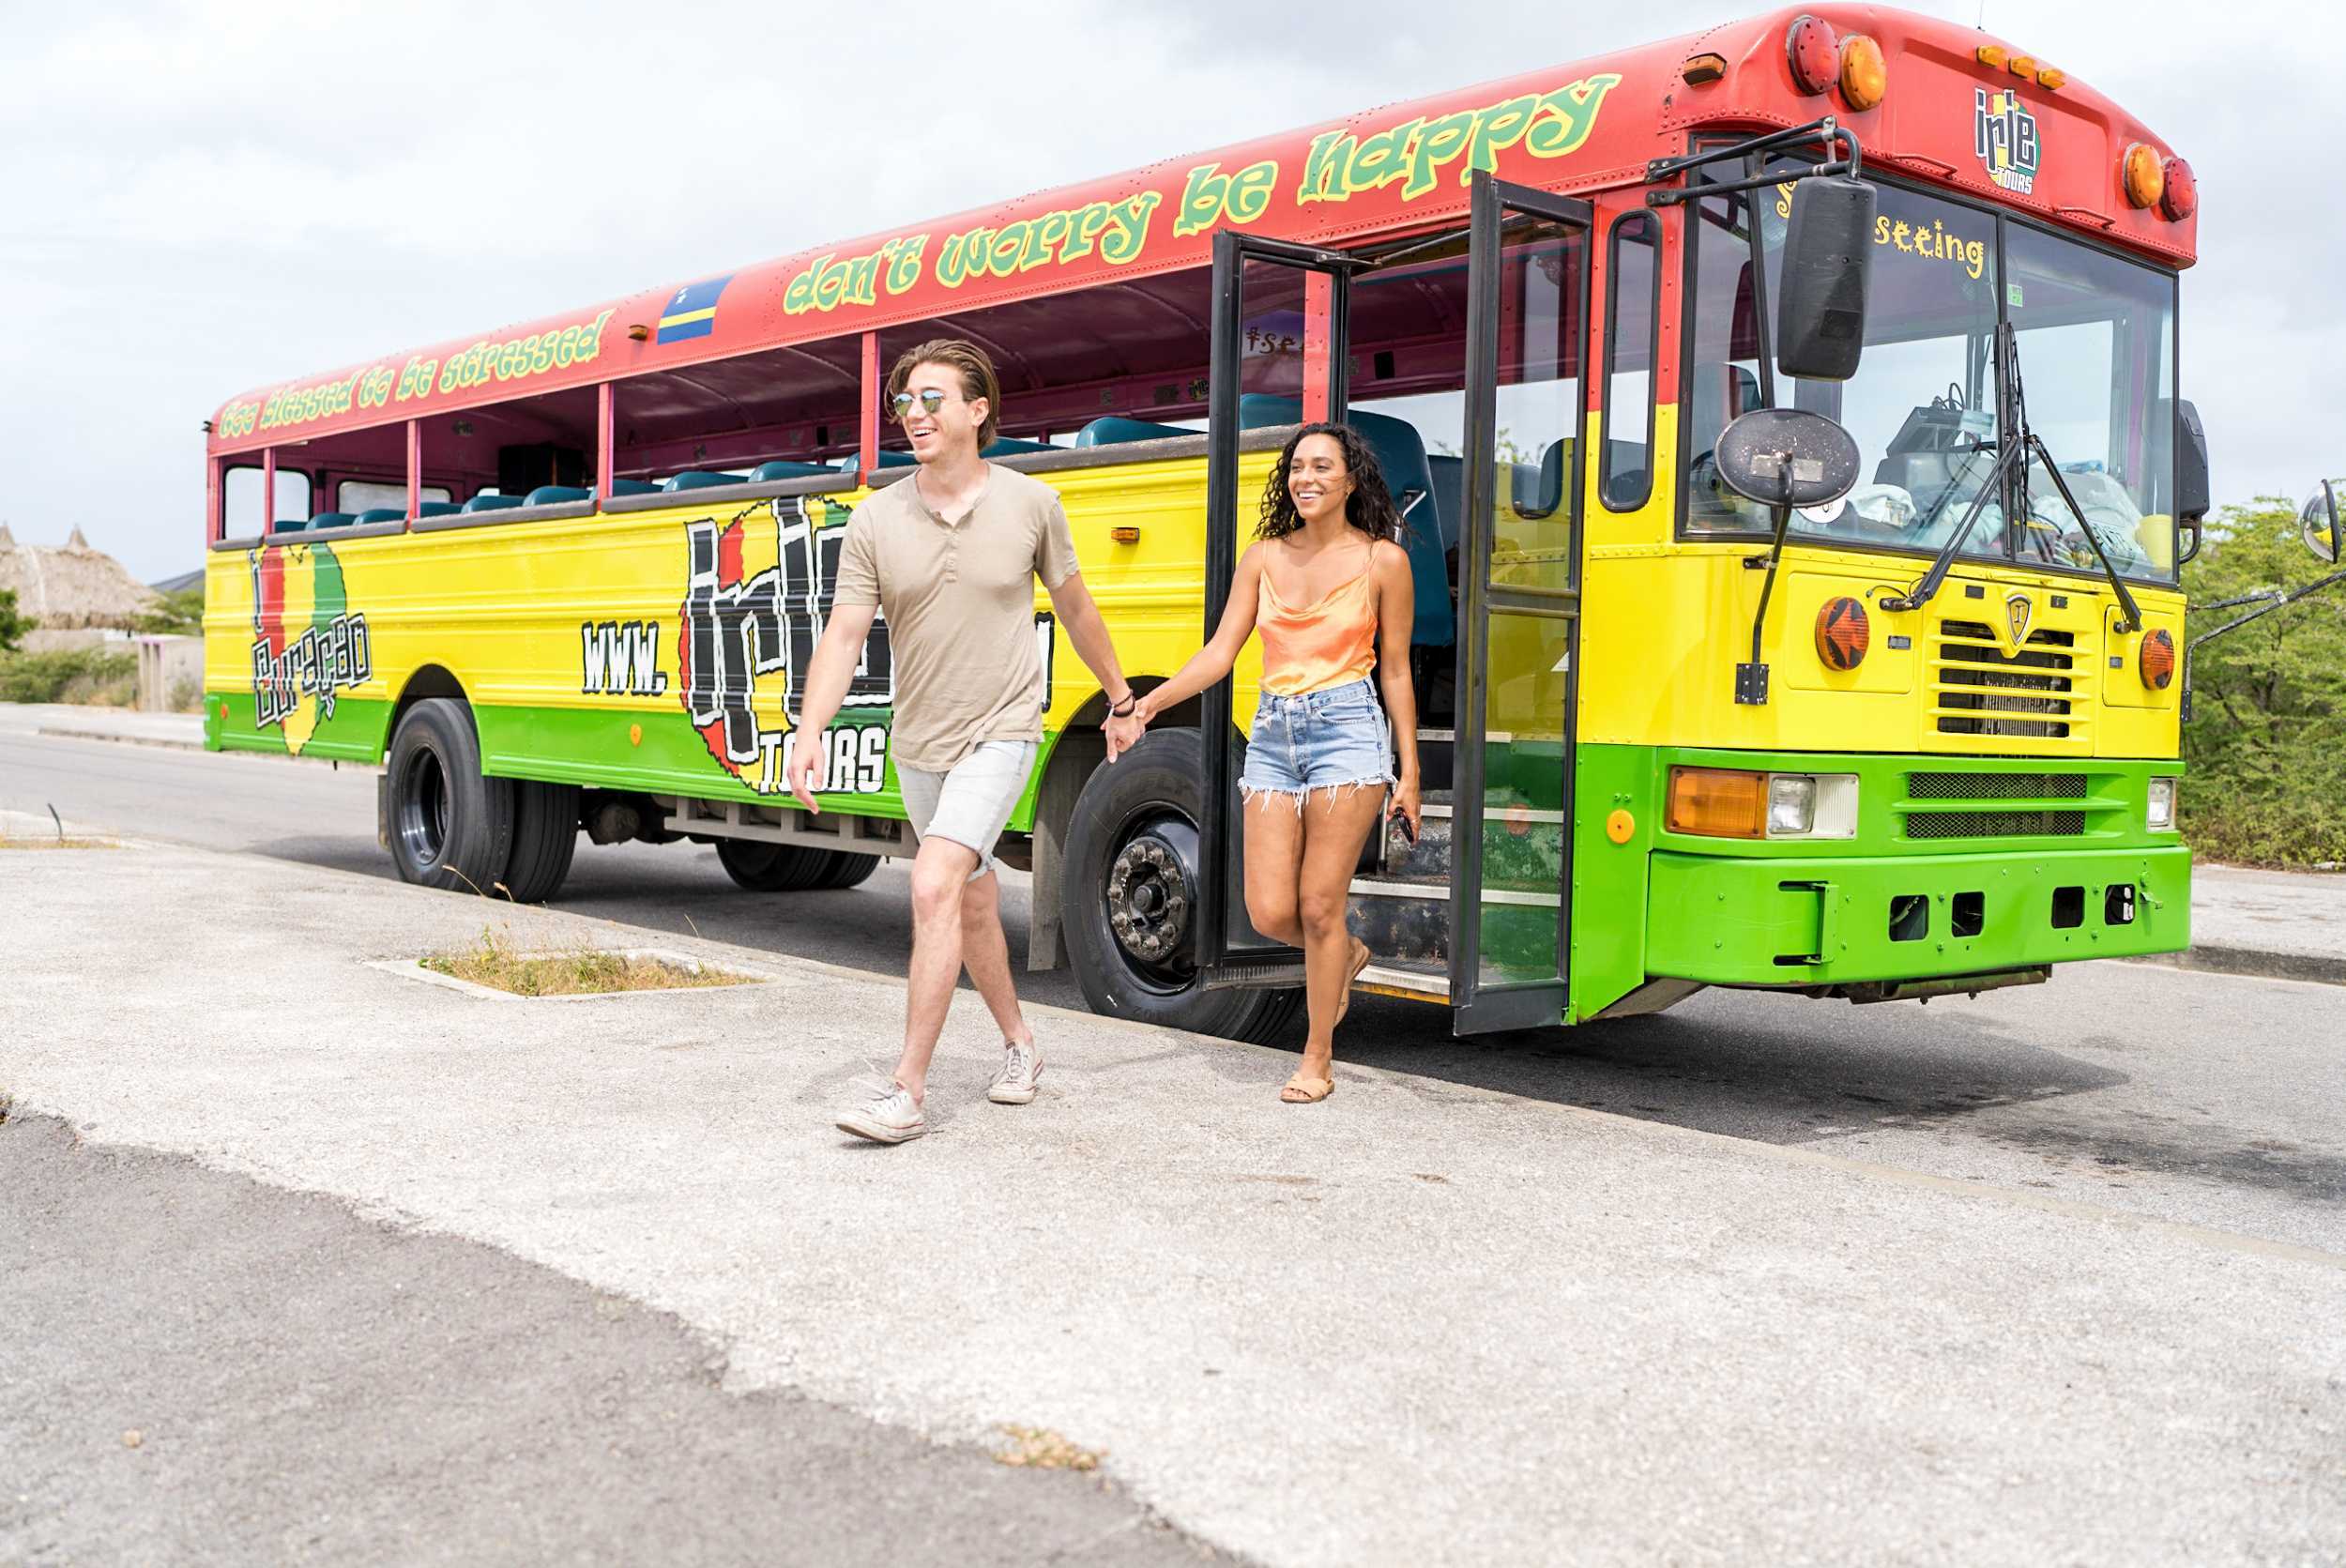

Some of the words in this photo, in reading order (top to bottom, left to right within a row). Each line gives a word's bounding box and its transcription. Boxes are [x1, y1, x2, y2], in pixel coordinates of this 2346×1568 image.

[1974, 87, 2036, 175] irie
[1996, 166, 2034, 195] TOURS
[784, 235, 927, 315] don't
[937, 191, 1159, 287] worry
[1173, 161, 1278, 237] be
[1299, 73, 1622, 203] happy
[219, 402, 258, 438] too
[261, 373, 358, 428] blessed
[358, 367, 394, 407] to
[396, 355, 434, 401] be
[440, 310, 616, 388] stressed
